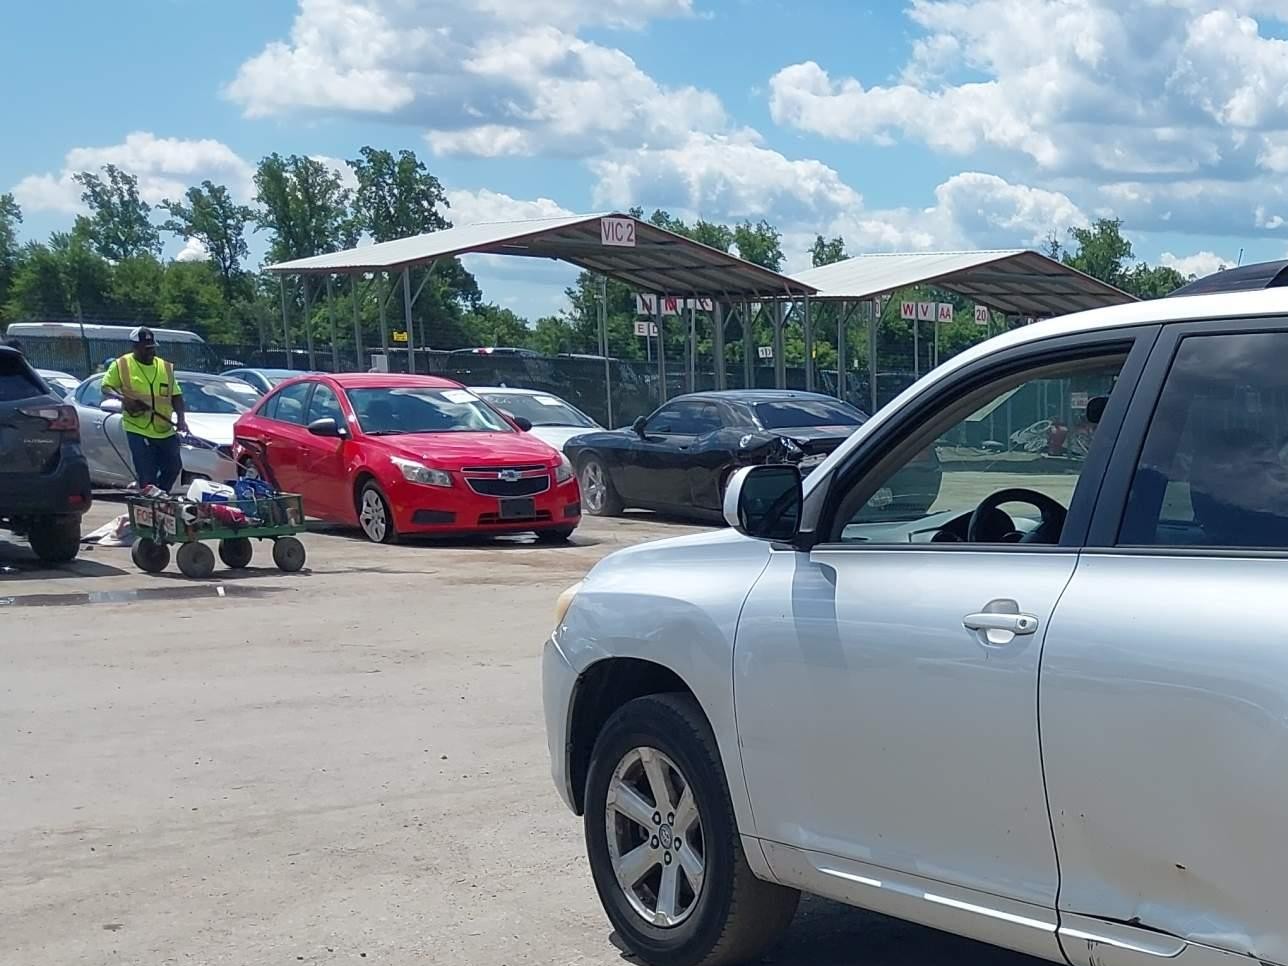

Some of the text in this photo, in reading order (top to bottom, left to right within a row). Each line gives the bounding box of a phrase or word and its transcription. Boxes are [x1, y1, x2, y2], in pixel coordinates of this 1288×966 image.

[602, 221, 634, 242] VIC 2
[903, 304, 914, 315] W
[920, 305, 929, 316] V
[939, 307, 951, 319] AA
[976, 309, 986, 320] 20
[638, 323, 645, 333] E
